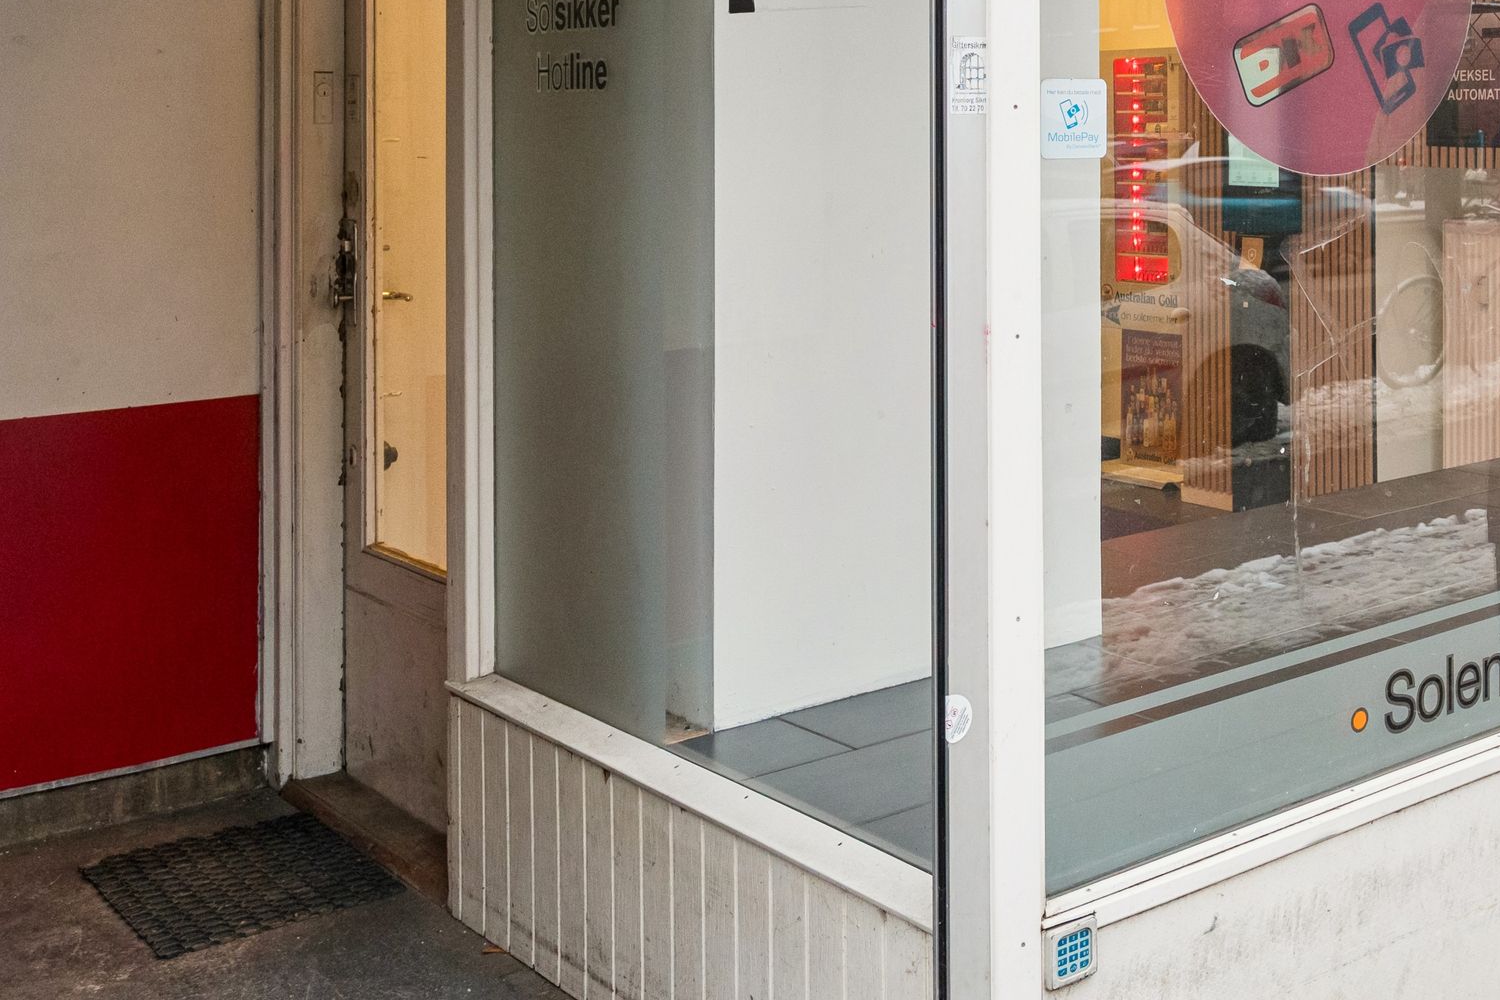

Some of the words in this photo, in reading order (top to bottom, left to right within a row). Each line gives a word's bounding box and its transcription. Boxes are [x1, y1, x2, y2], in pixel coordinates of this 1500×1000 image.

[537, 52, 608, 91] Hotline
[1453, 69, 1496, 82] VEKSEL
[1447, 88, 1500, 101] AUTOMAT
[1047, 132, 1099, 143] MobilePay
[1114, 290, 1156, 305] Australian
[1158, 294, 1178, 308] Gold
